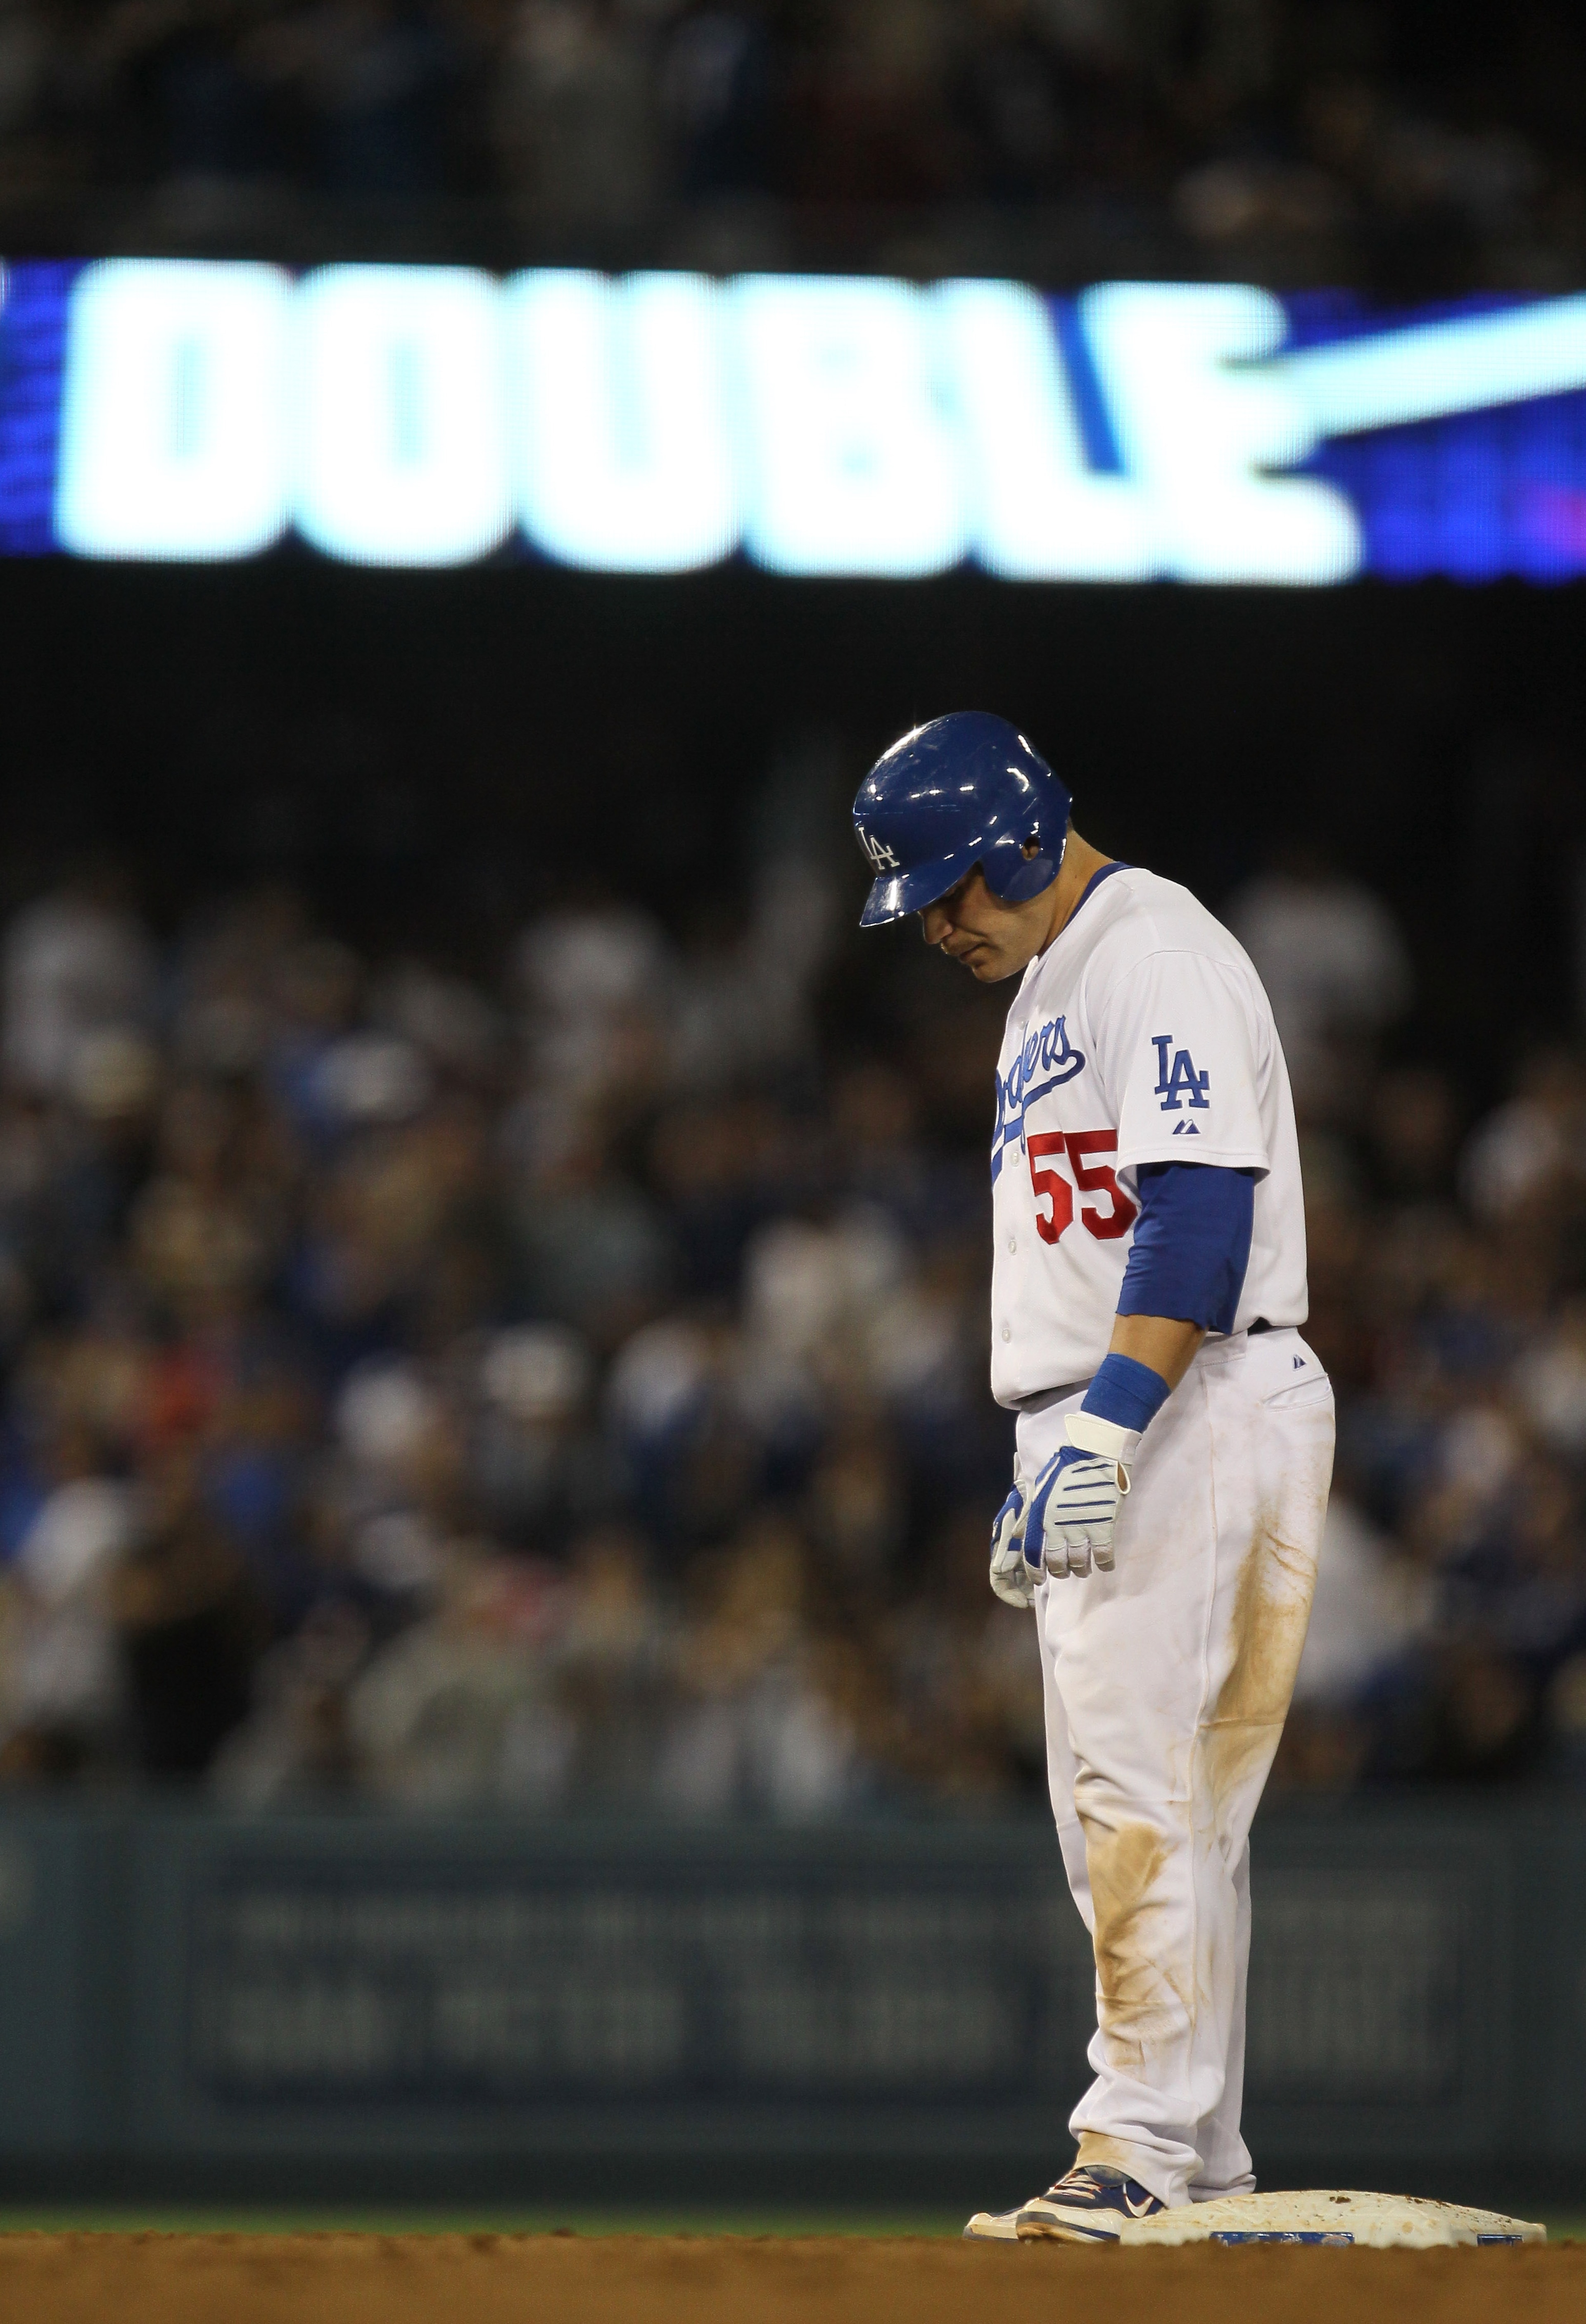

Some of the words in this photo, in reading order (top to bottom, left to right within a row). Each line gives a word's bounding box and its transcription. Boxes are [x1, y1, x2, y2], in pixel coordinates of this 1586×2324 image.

[53, 258, 1365, 586] DOUBLE
[858, 826, 900, 870] LA
[992, 1015, 1085, 1156] dgers
[1152, 1034, 1209, 1111] LA
[1027, 1129, 1137, 1245] 55
